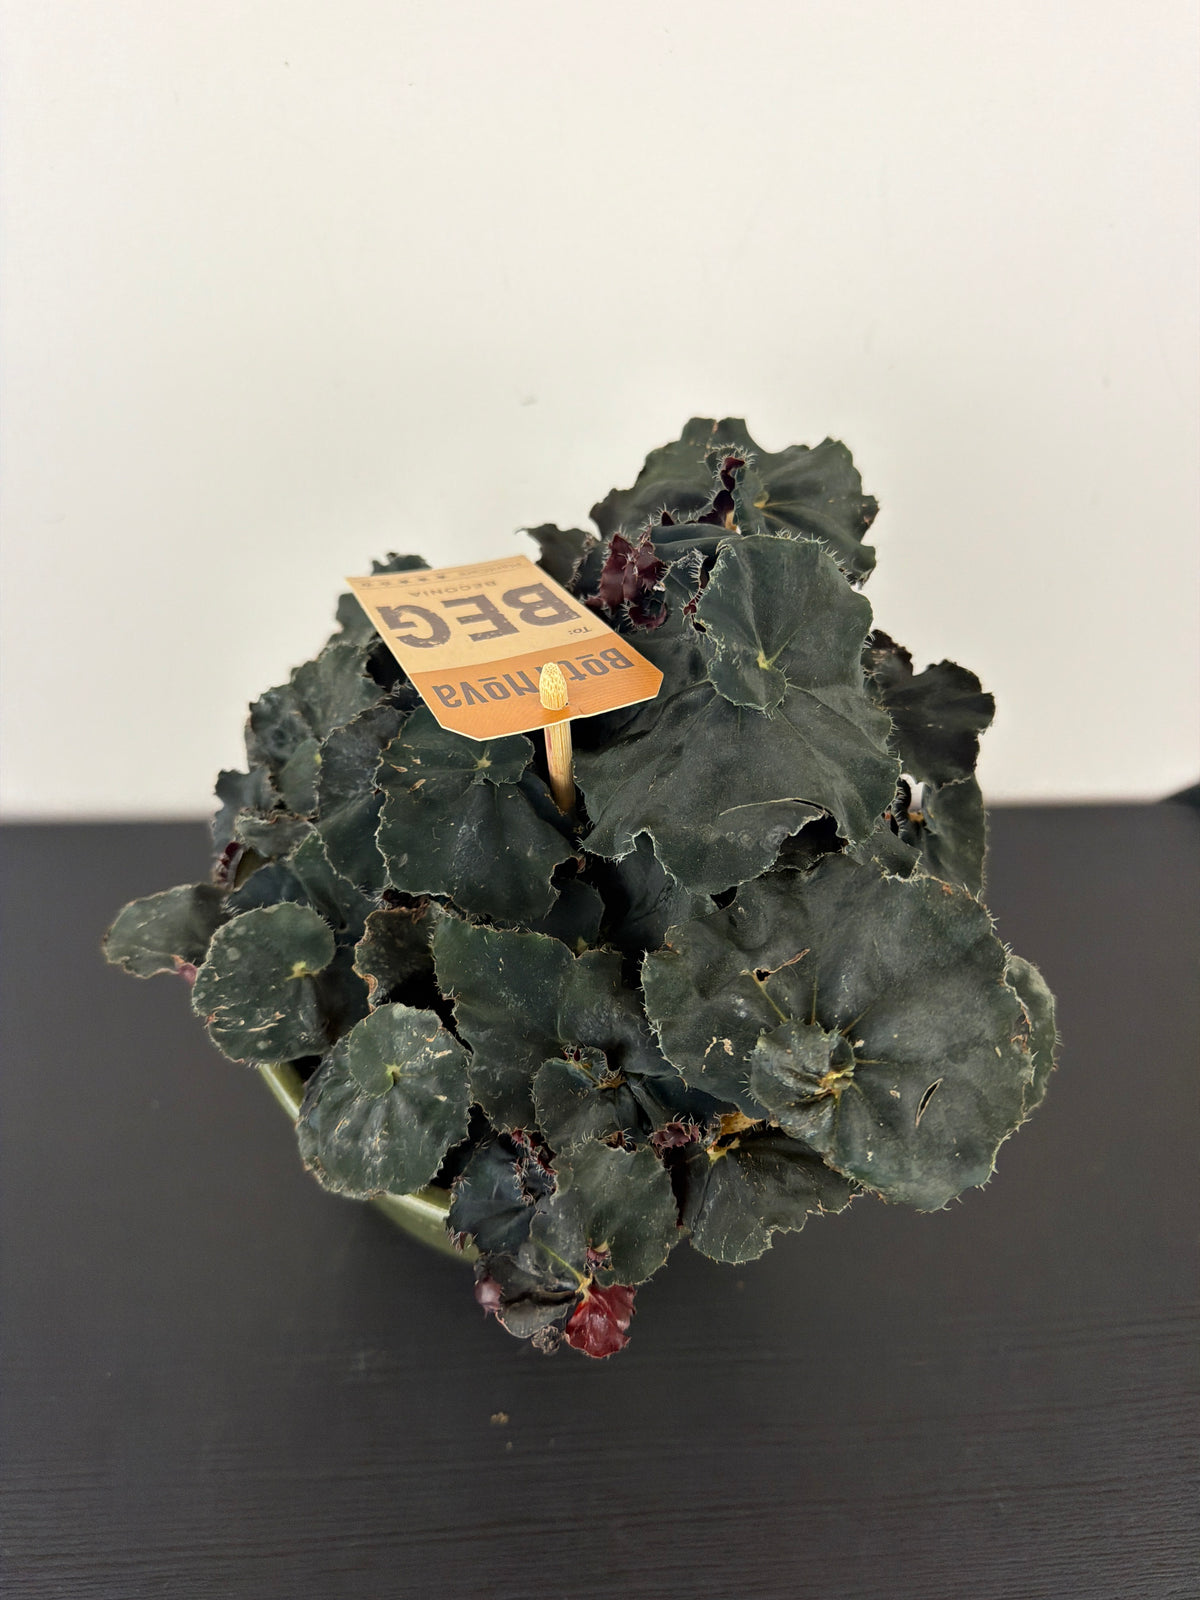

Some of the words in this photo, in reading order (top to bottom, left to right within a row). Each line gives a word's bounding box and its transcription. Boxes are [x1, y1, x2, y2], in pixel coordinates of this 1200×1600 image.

[409, 580, 497, 597] BEGONIA
[376, 582, 581, 648] BEG
[568, 625, 592, 636] To:
[432, 648, 635, 708] BotNova
